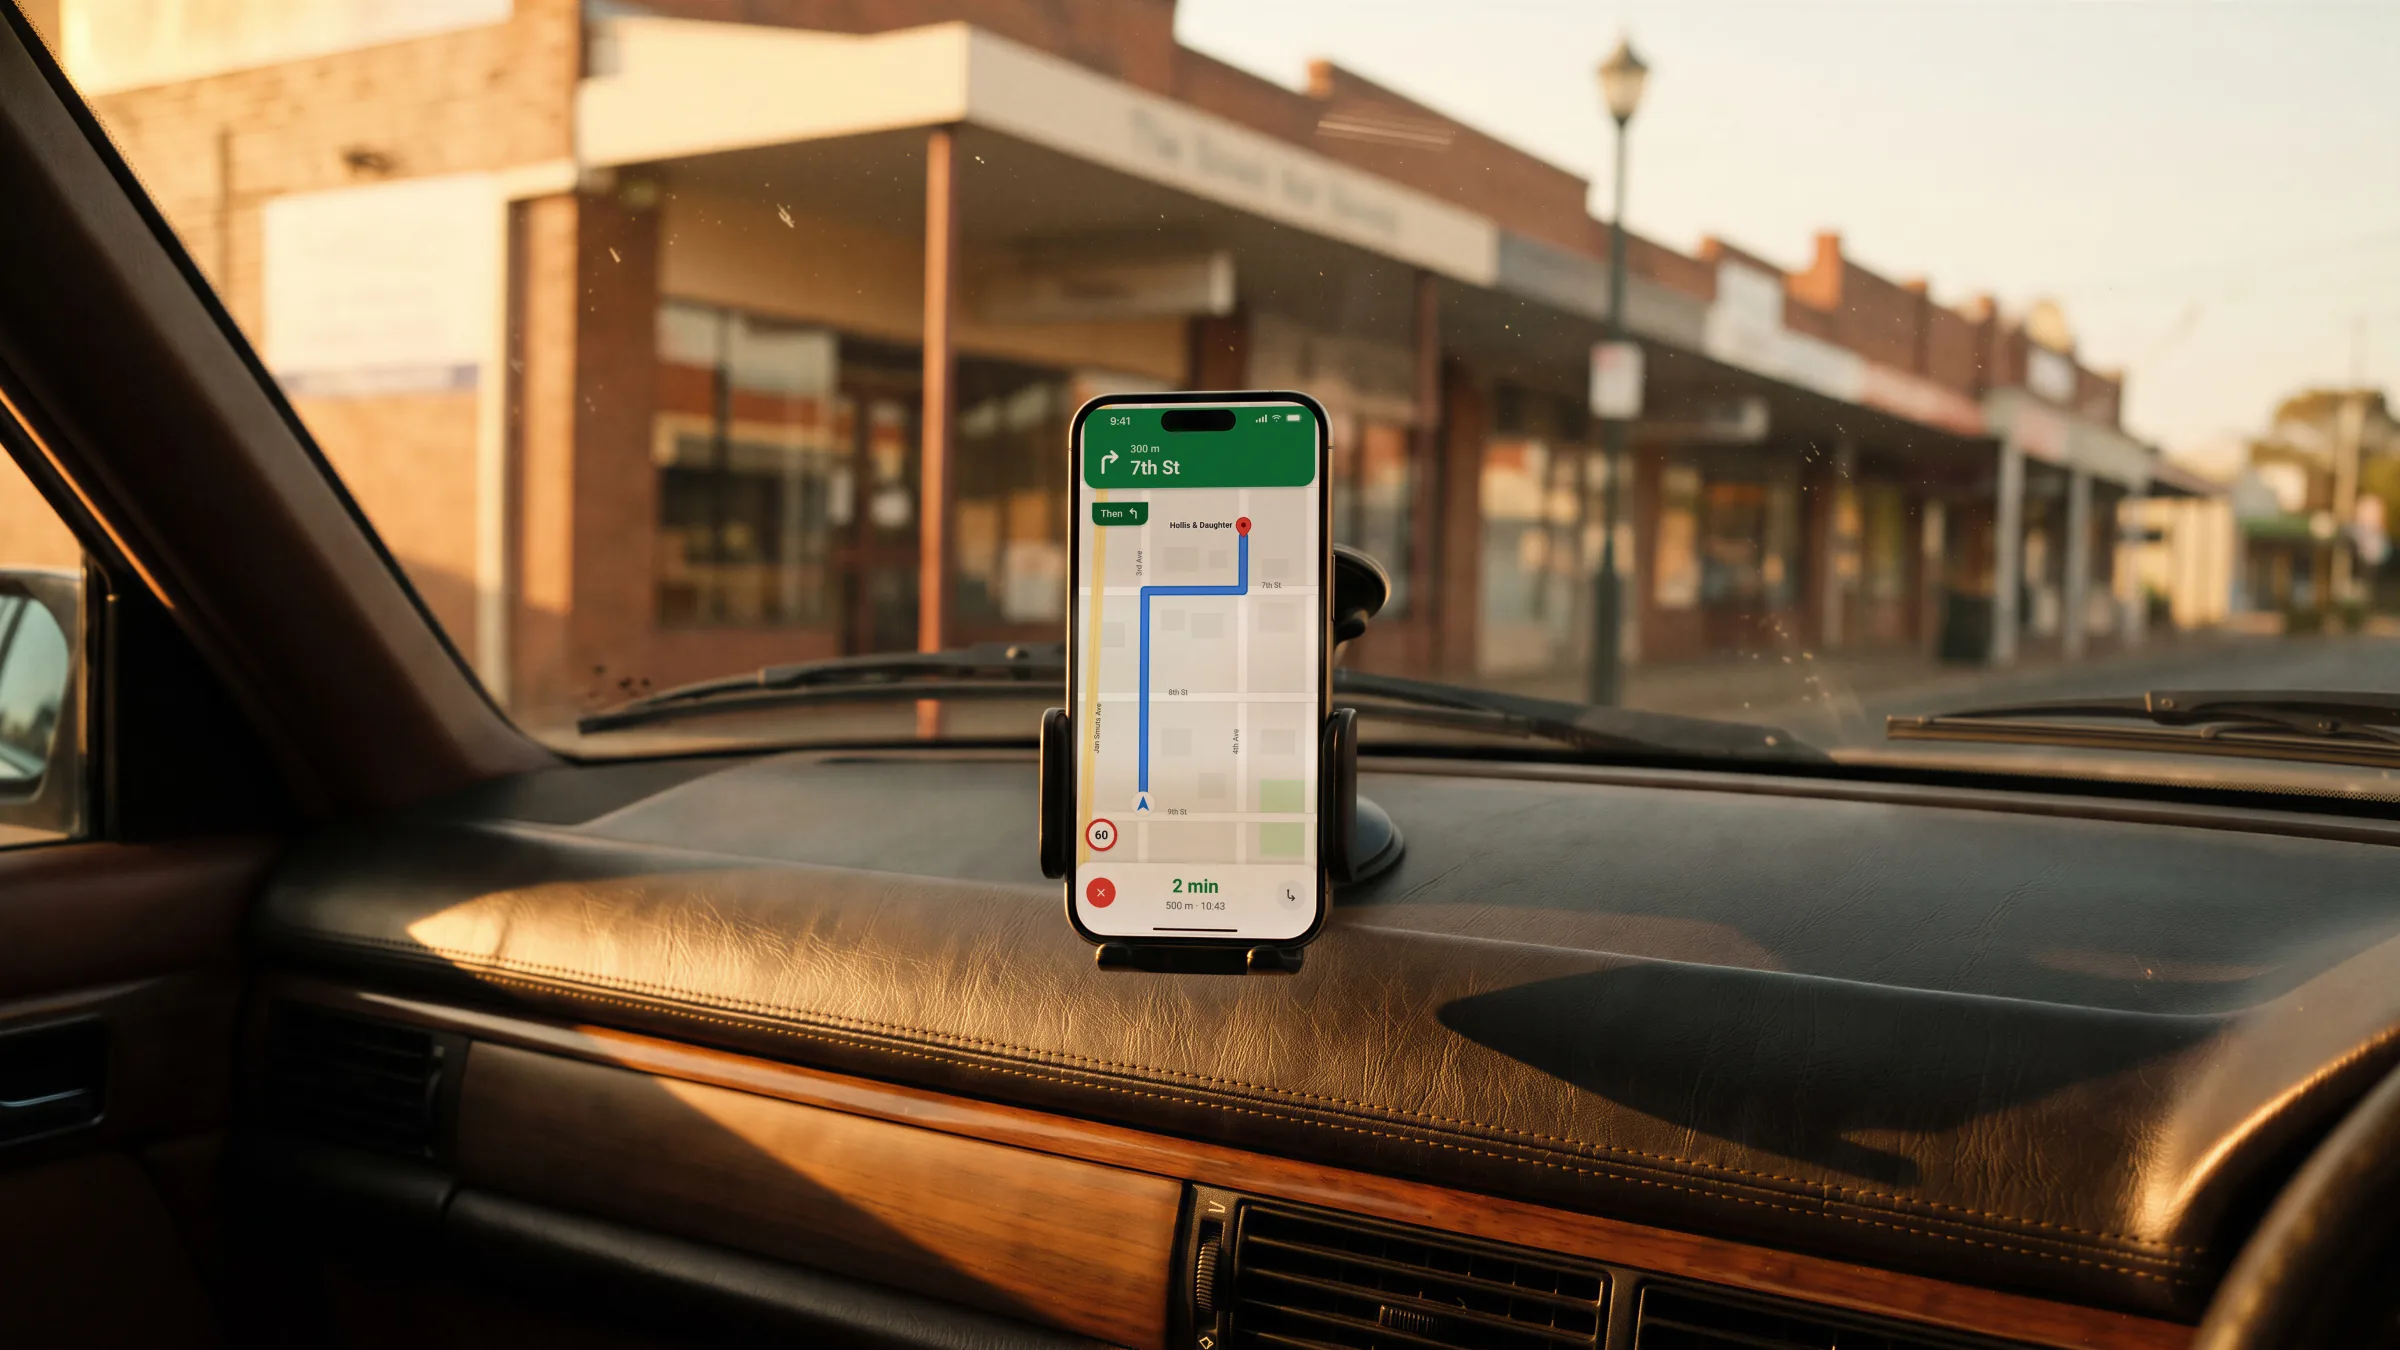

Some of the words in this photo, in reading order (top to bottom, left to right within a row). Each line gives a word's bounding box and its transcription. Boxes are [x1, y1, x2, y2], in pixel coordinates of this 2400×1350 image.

[1110, 416, 1131, 426] 9:41
[1130, 444, 1149, 454] 300
[1130, 460, 1158, 475] 7th
[1163, 460, 1181, 475] St
[1101, 509, 1123, 518] Then
[1169, 521, 1191, 529] Hollis
[1192, 521, 1198, 529] &
[1199, 521, 1233, 531] Daughter
[1094, 703, 1102, 716] Ave
[1094, 717, 1102, 741] Smuts
[1094, 829, 1109, 840] 60
[1172, 879, 1183, 894] 2
[1188, 879, 1219, 894] min
[1166, 901, 1182, 910] 500
[1201, 901, 1226, 911] 10:43
